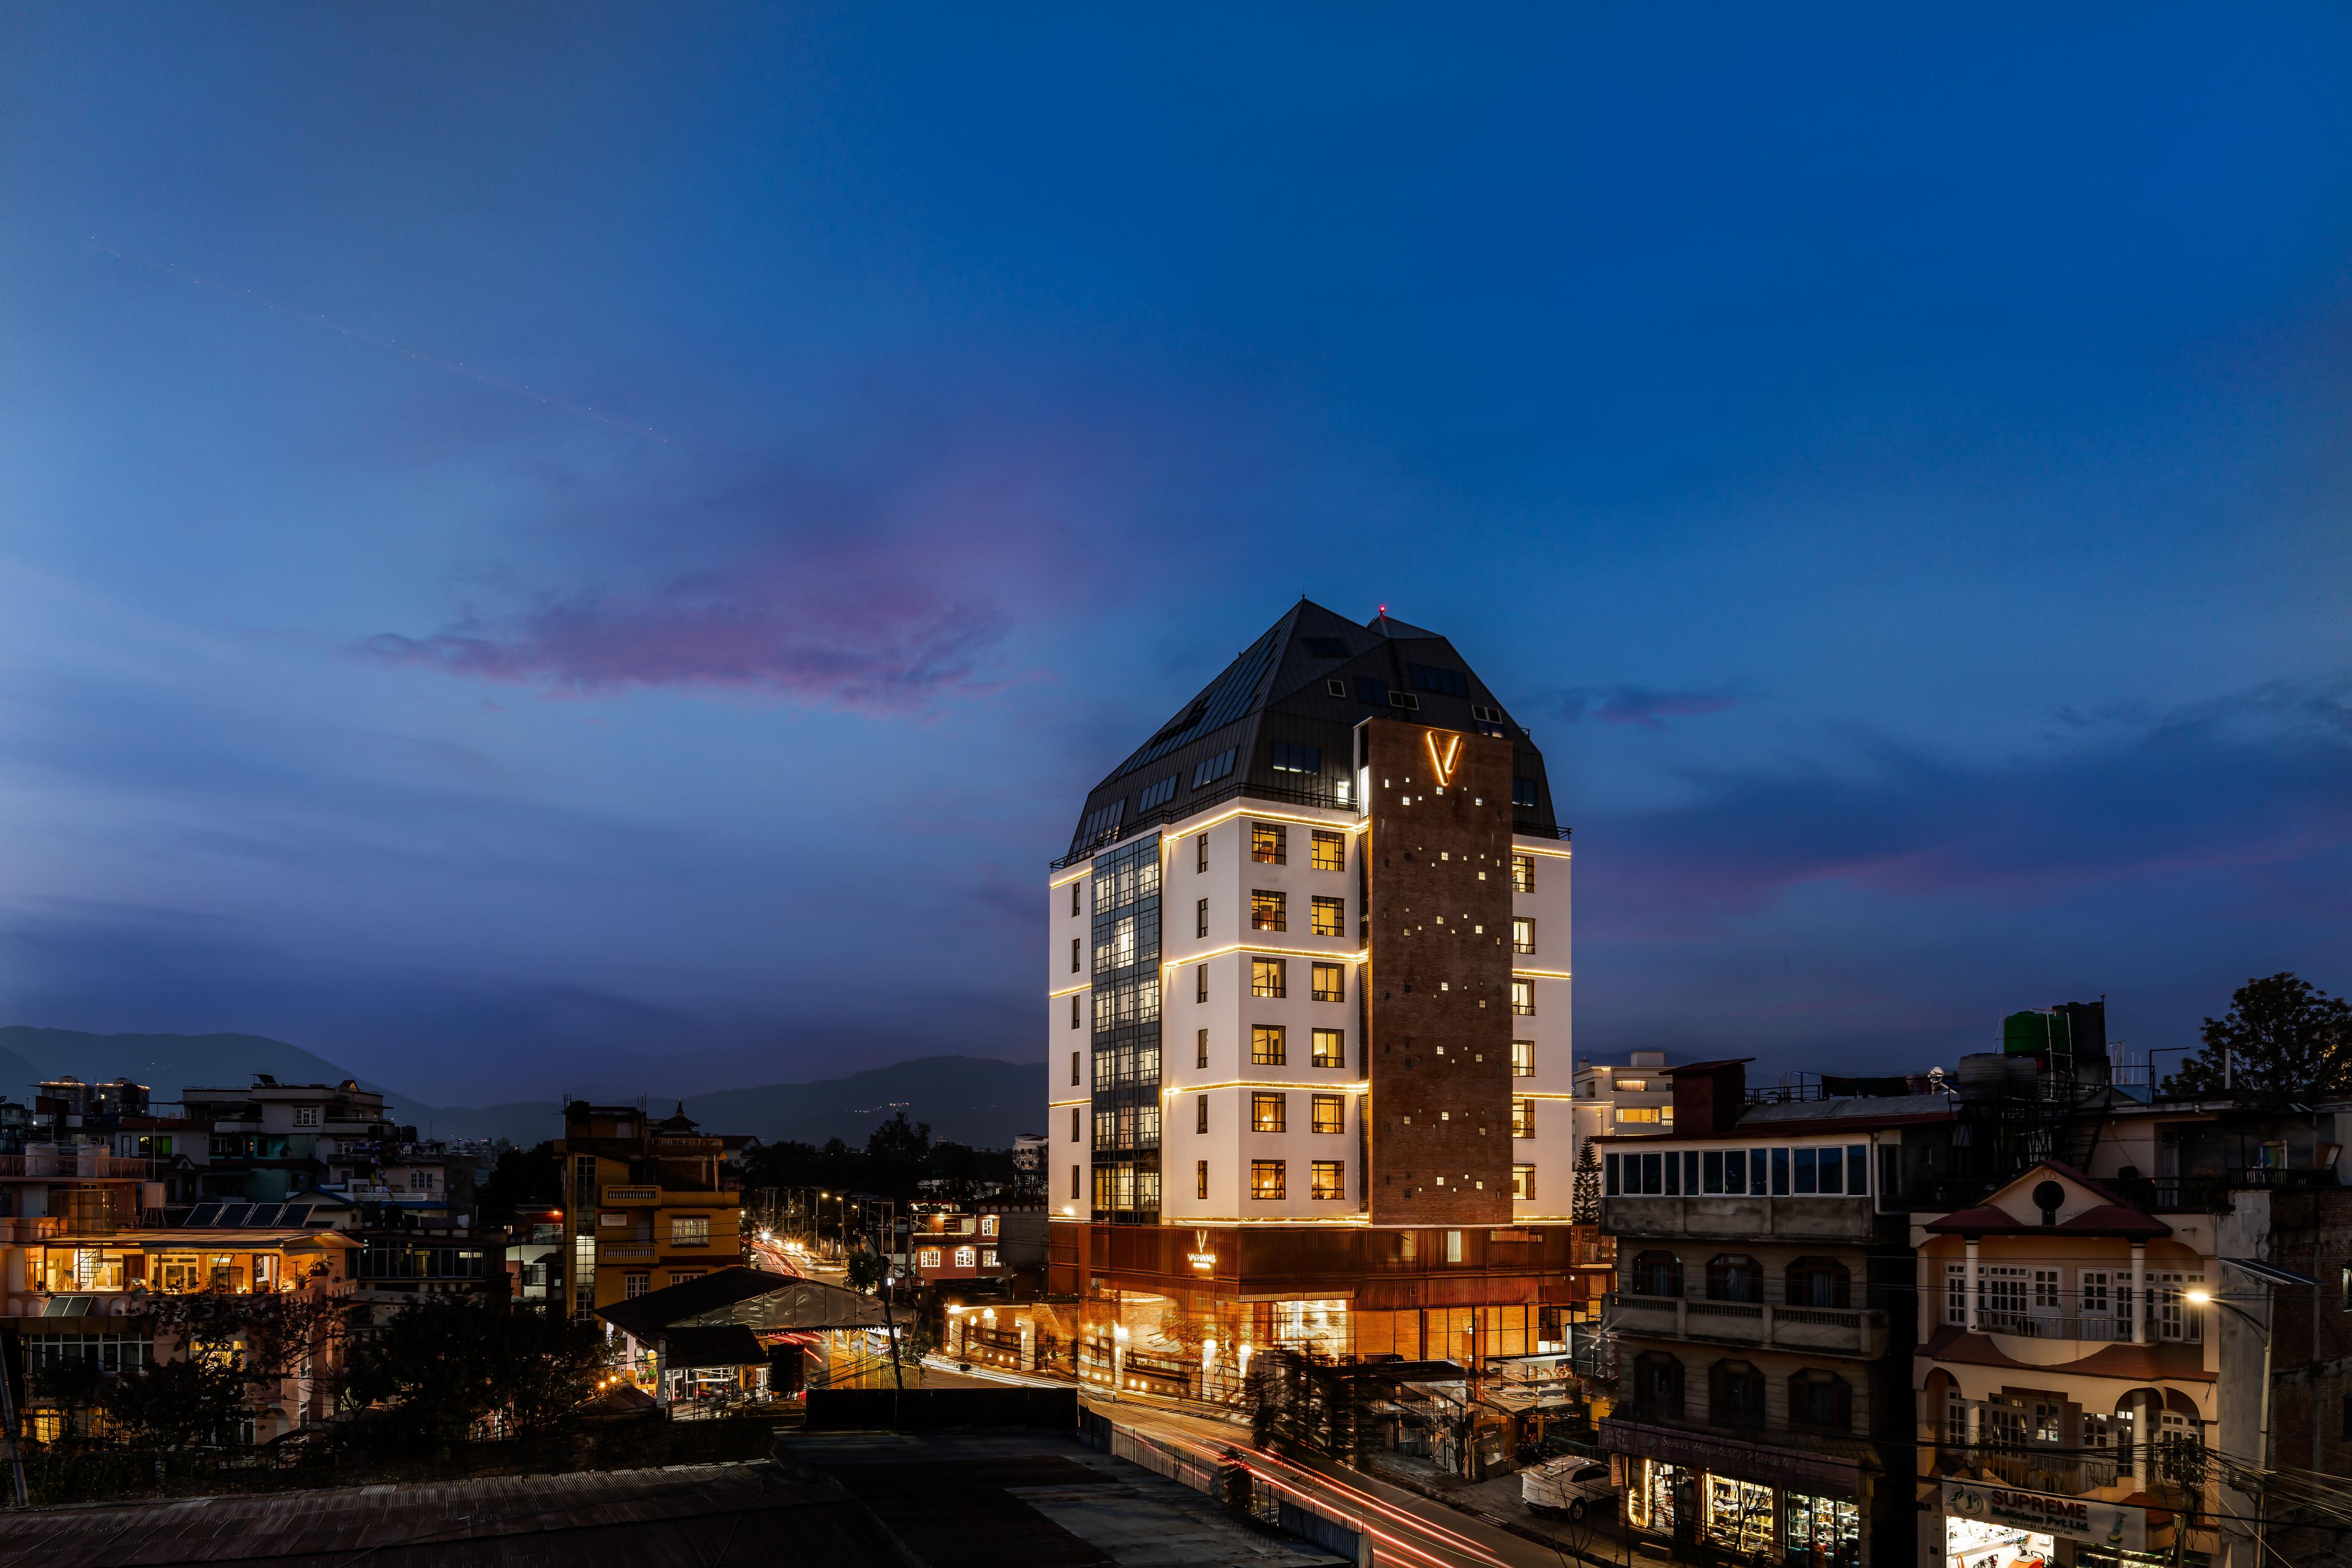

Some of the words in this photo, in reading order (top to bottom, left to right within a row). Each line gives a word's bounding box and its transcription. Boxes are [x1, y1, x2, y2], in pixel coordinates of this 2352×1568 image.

[1427, 731, 1461, 786] V
[1661, 1436, 1688, 1450] Sepals
[1693, 1442, 1741, 1463] Hospitality
[1747, 1451, 1789, 1468] Products
[1991, 1506, 2044, 1523] Multiclean
[2070, 1520, 2090, 1531] Ltd.
[1992, 1490, 2087, 1520] SUPREME
